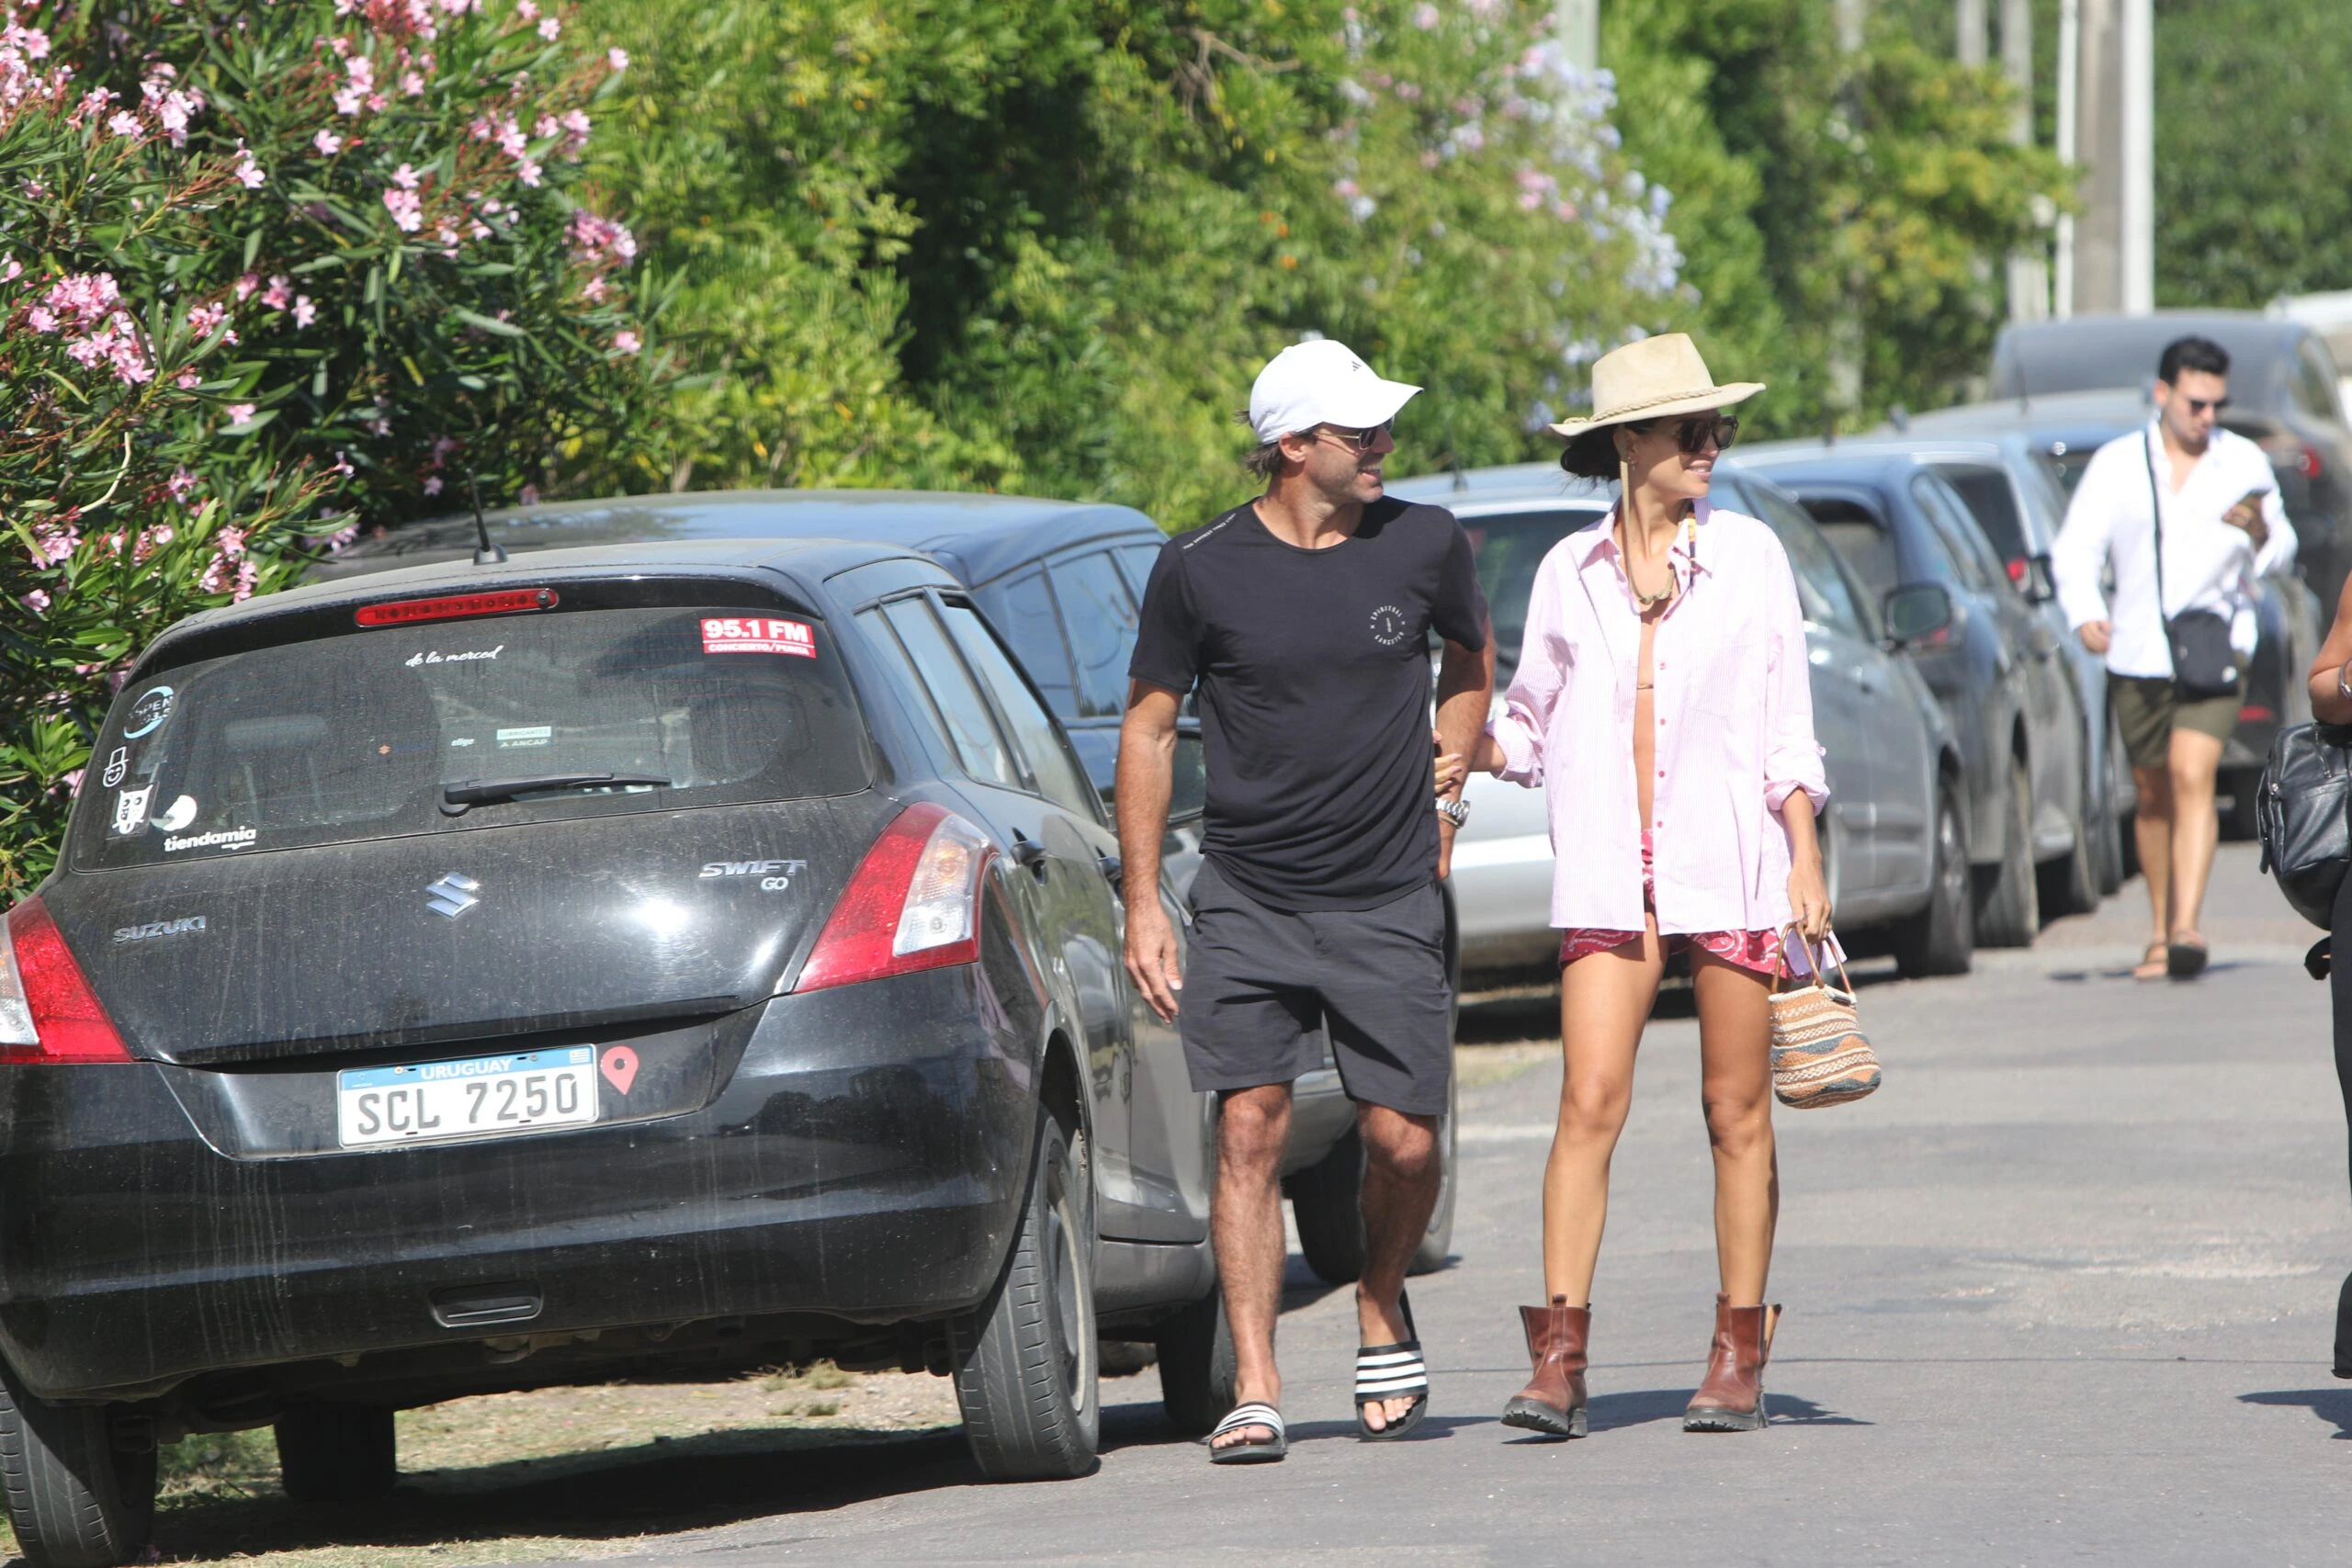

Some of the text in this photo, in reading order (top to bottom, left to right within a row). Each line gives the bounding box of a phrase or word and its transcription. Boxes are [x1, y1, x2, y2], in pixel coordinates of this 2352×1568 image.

[704, 619, 809, 643] 95.1 FM
[405, 645, 504, 667] de la merced
[512, 739, 548, 747] ANCAP
[164, 826, 257, 852] tiendamia
[698, 860, 808, 878] SWIFT
[761, 876, 789, 890] GO
[113, 915, 206, 943] SUZUKI
[421, 1058, 513, 1080] URUGUAY
[357, 1073, 578, 1135] SCL 7250
